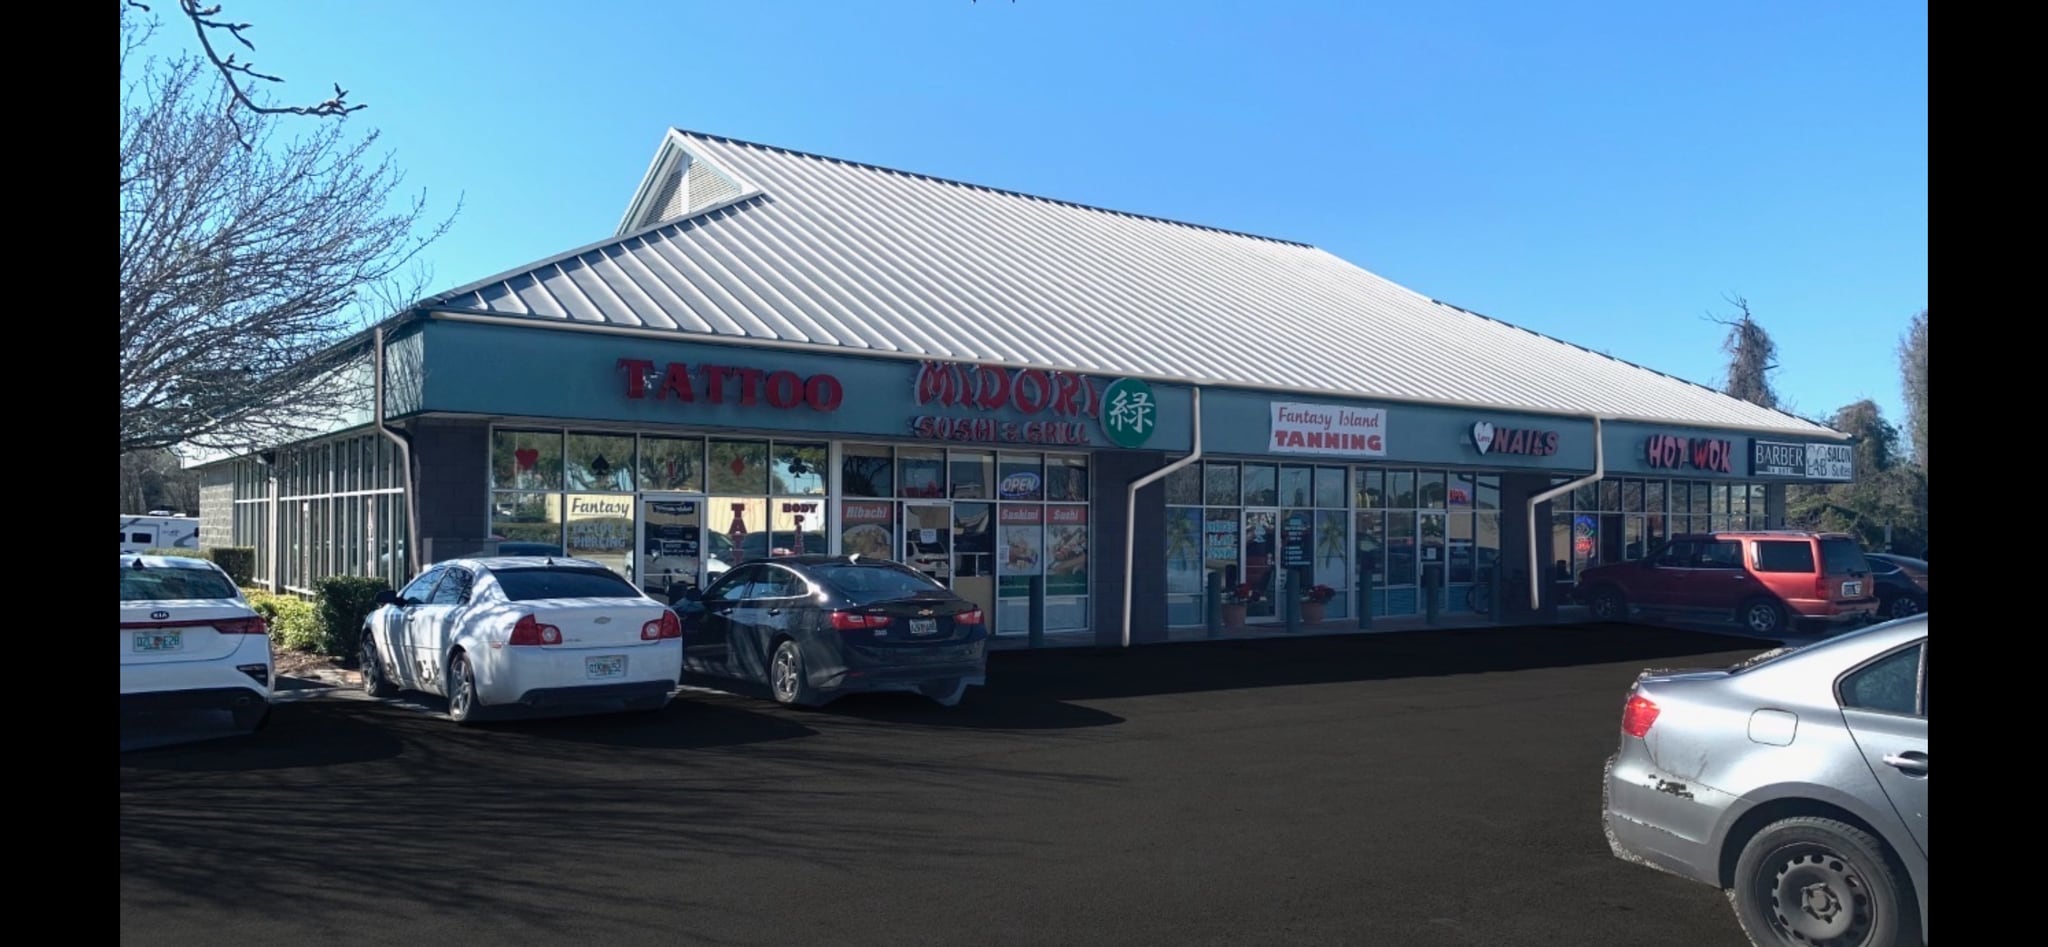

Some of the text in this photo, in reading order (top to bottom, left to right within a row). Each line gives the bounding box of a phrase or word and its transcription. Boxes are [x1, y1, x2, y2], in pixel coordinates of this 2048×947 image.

[617, 358, 843, 412] TATTOO
[914, 361, 1099, 419] MIDORI
[1109, 390, 1154, 434] 緑
[1279, 406, 1380, 430] Fantasy Island
[913, 416, 997, 442] SUSHI
[1024, 422, 1091, 444] GRILL
[1275, 430, 1382, 451] TANNING
[1493, 427, 1559, 456] NAILS
[1648, 434, 1733, 473] HOT WOK
[1756, 445, 1804, 467] BARBER
[1827, 446, 1851, 463] SALON
[1003, 478, 1036, 492] OPEN
[571, 498, 630, 518] Fantasy
[783, 503, 817, 513] BODY
